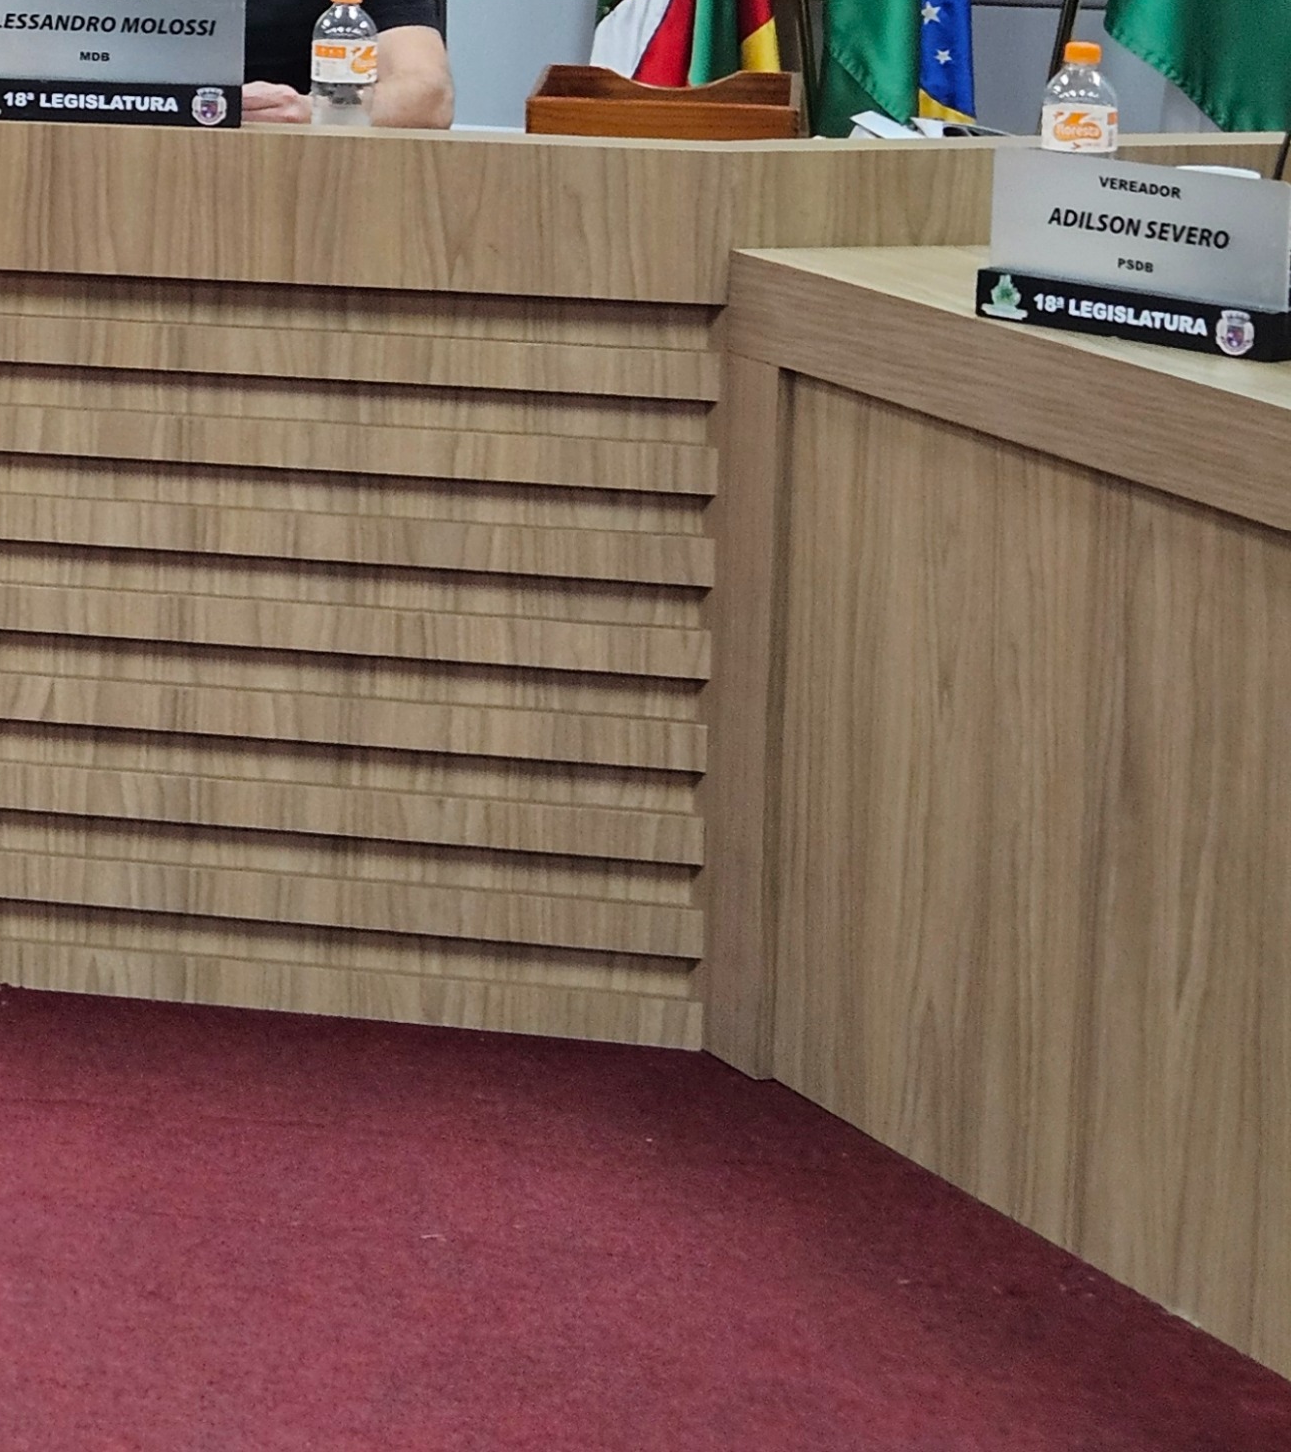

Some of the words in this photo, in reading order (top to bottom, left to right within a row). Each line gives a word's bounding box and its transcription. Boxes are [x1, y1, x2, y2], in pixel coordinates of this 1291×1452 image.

[121, 17, 216, 36] MOLOSSI
[80, 52, 110, 61] MDB
[4, 92, 34, 107] 18ª
[39, 93, 178, 112] LEGISLATURA
[1099, 176, 1182, 199] VEREADOR
[1048, 208, 1141, 237] ADILSON
[1145, 221, 1230, 249] SEVERO
[1117, 258, 1153, 272] PSDB
[1034, 293, 1064, 312] 18ª
[1068, 299, 1208, 336] LEGISLATURA
